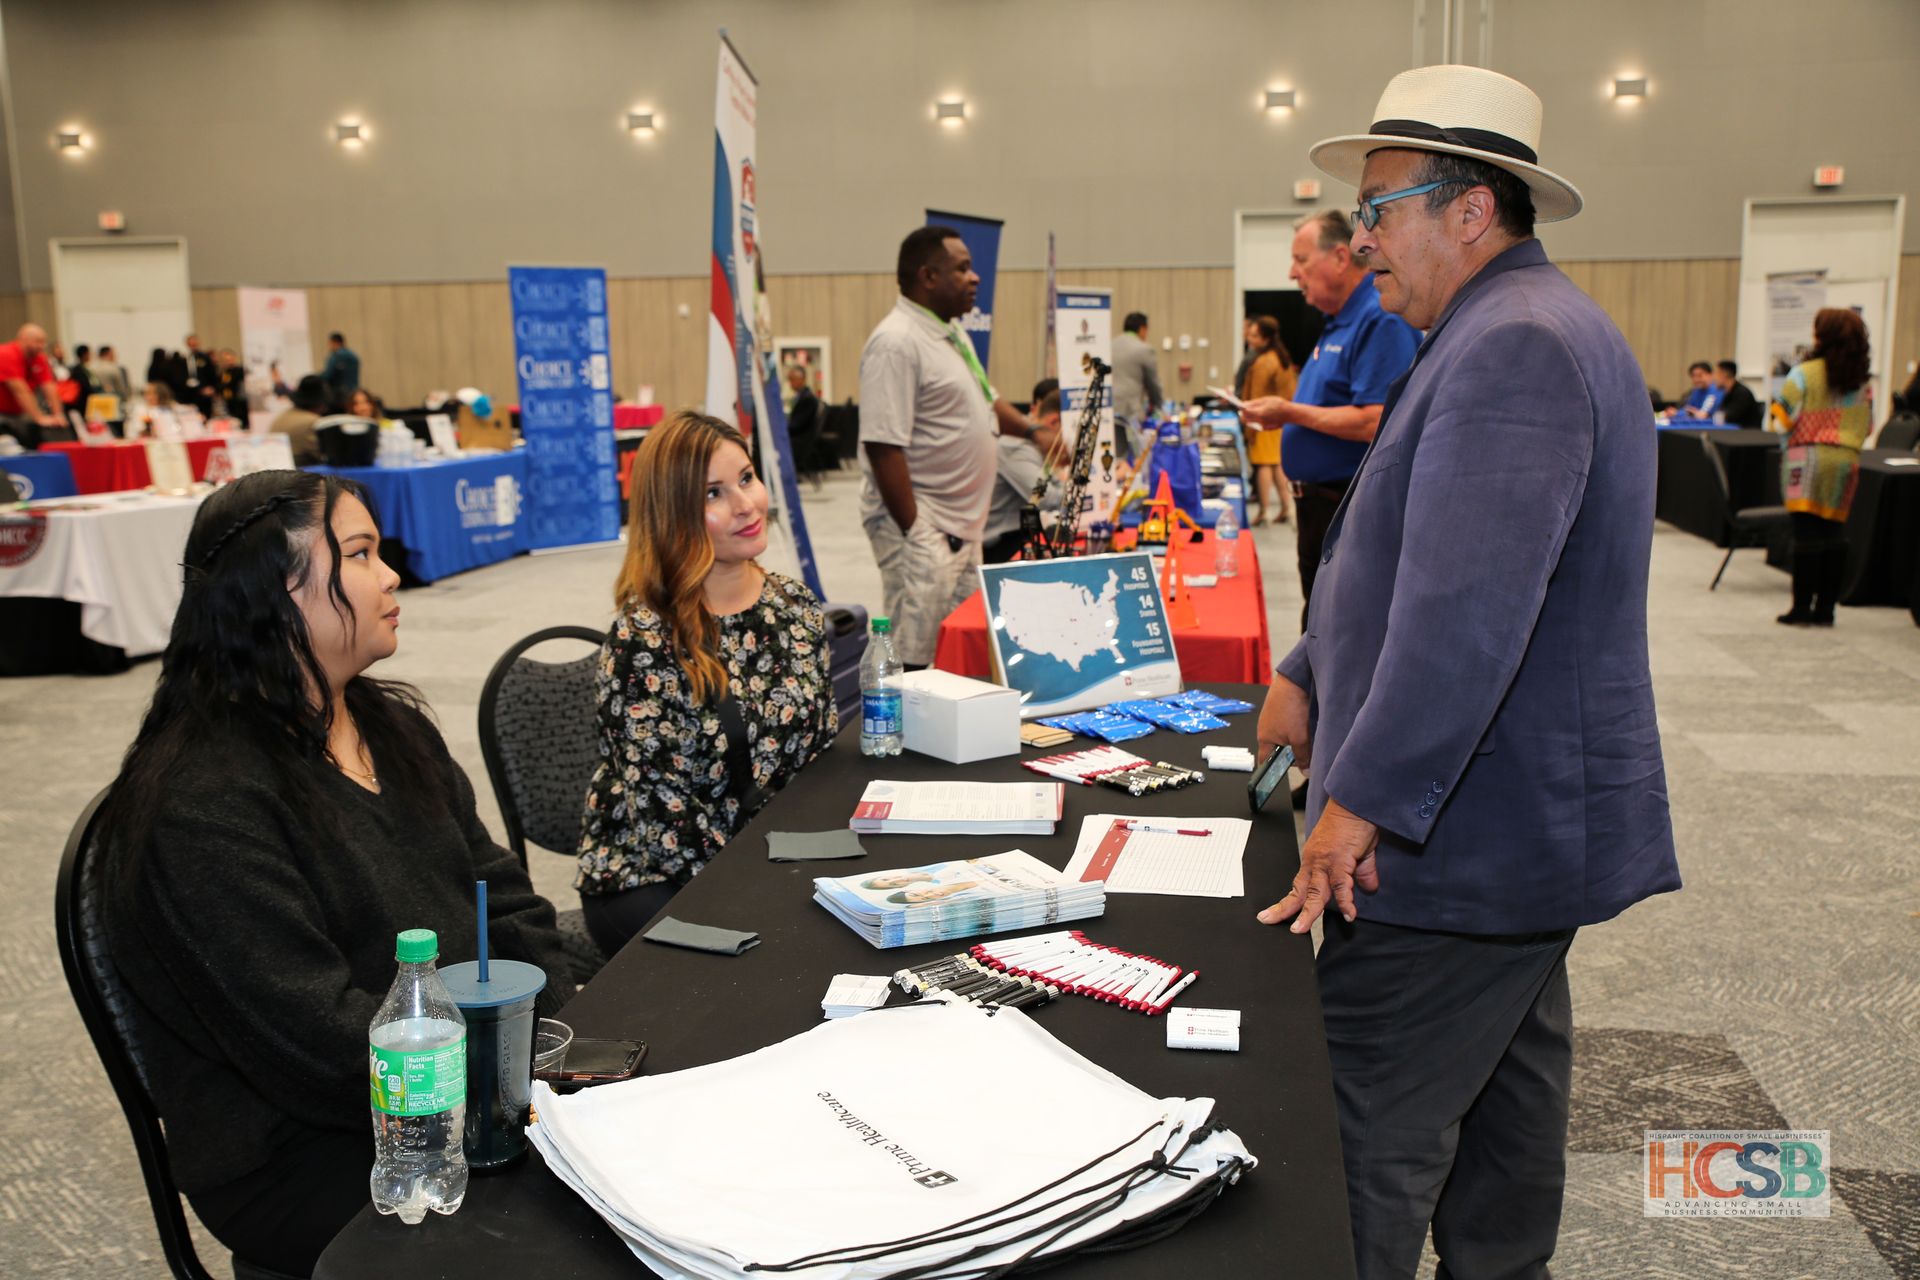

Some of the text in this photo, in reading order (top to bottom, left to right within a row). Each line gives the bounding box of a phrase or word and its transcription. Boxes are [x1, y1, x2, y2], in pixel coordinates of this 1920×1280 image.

[1131, 567, 1147, 581] 45
[1138, 594, 1154, 609] 14
[1145, 622, 1161, 637] 15
[503, 1031, 511, 1065] GLASS
[817, 1091, 932, 1175] Prime Healthcare
